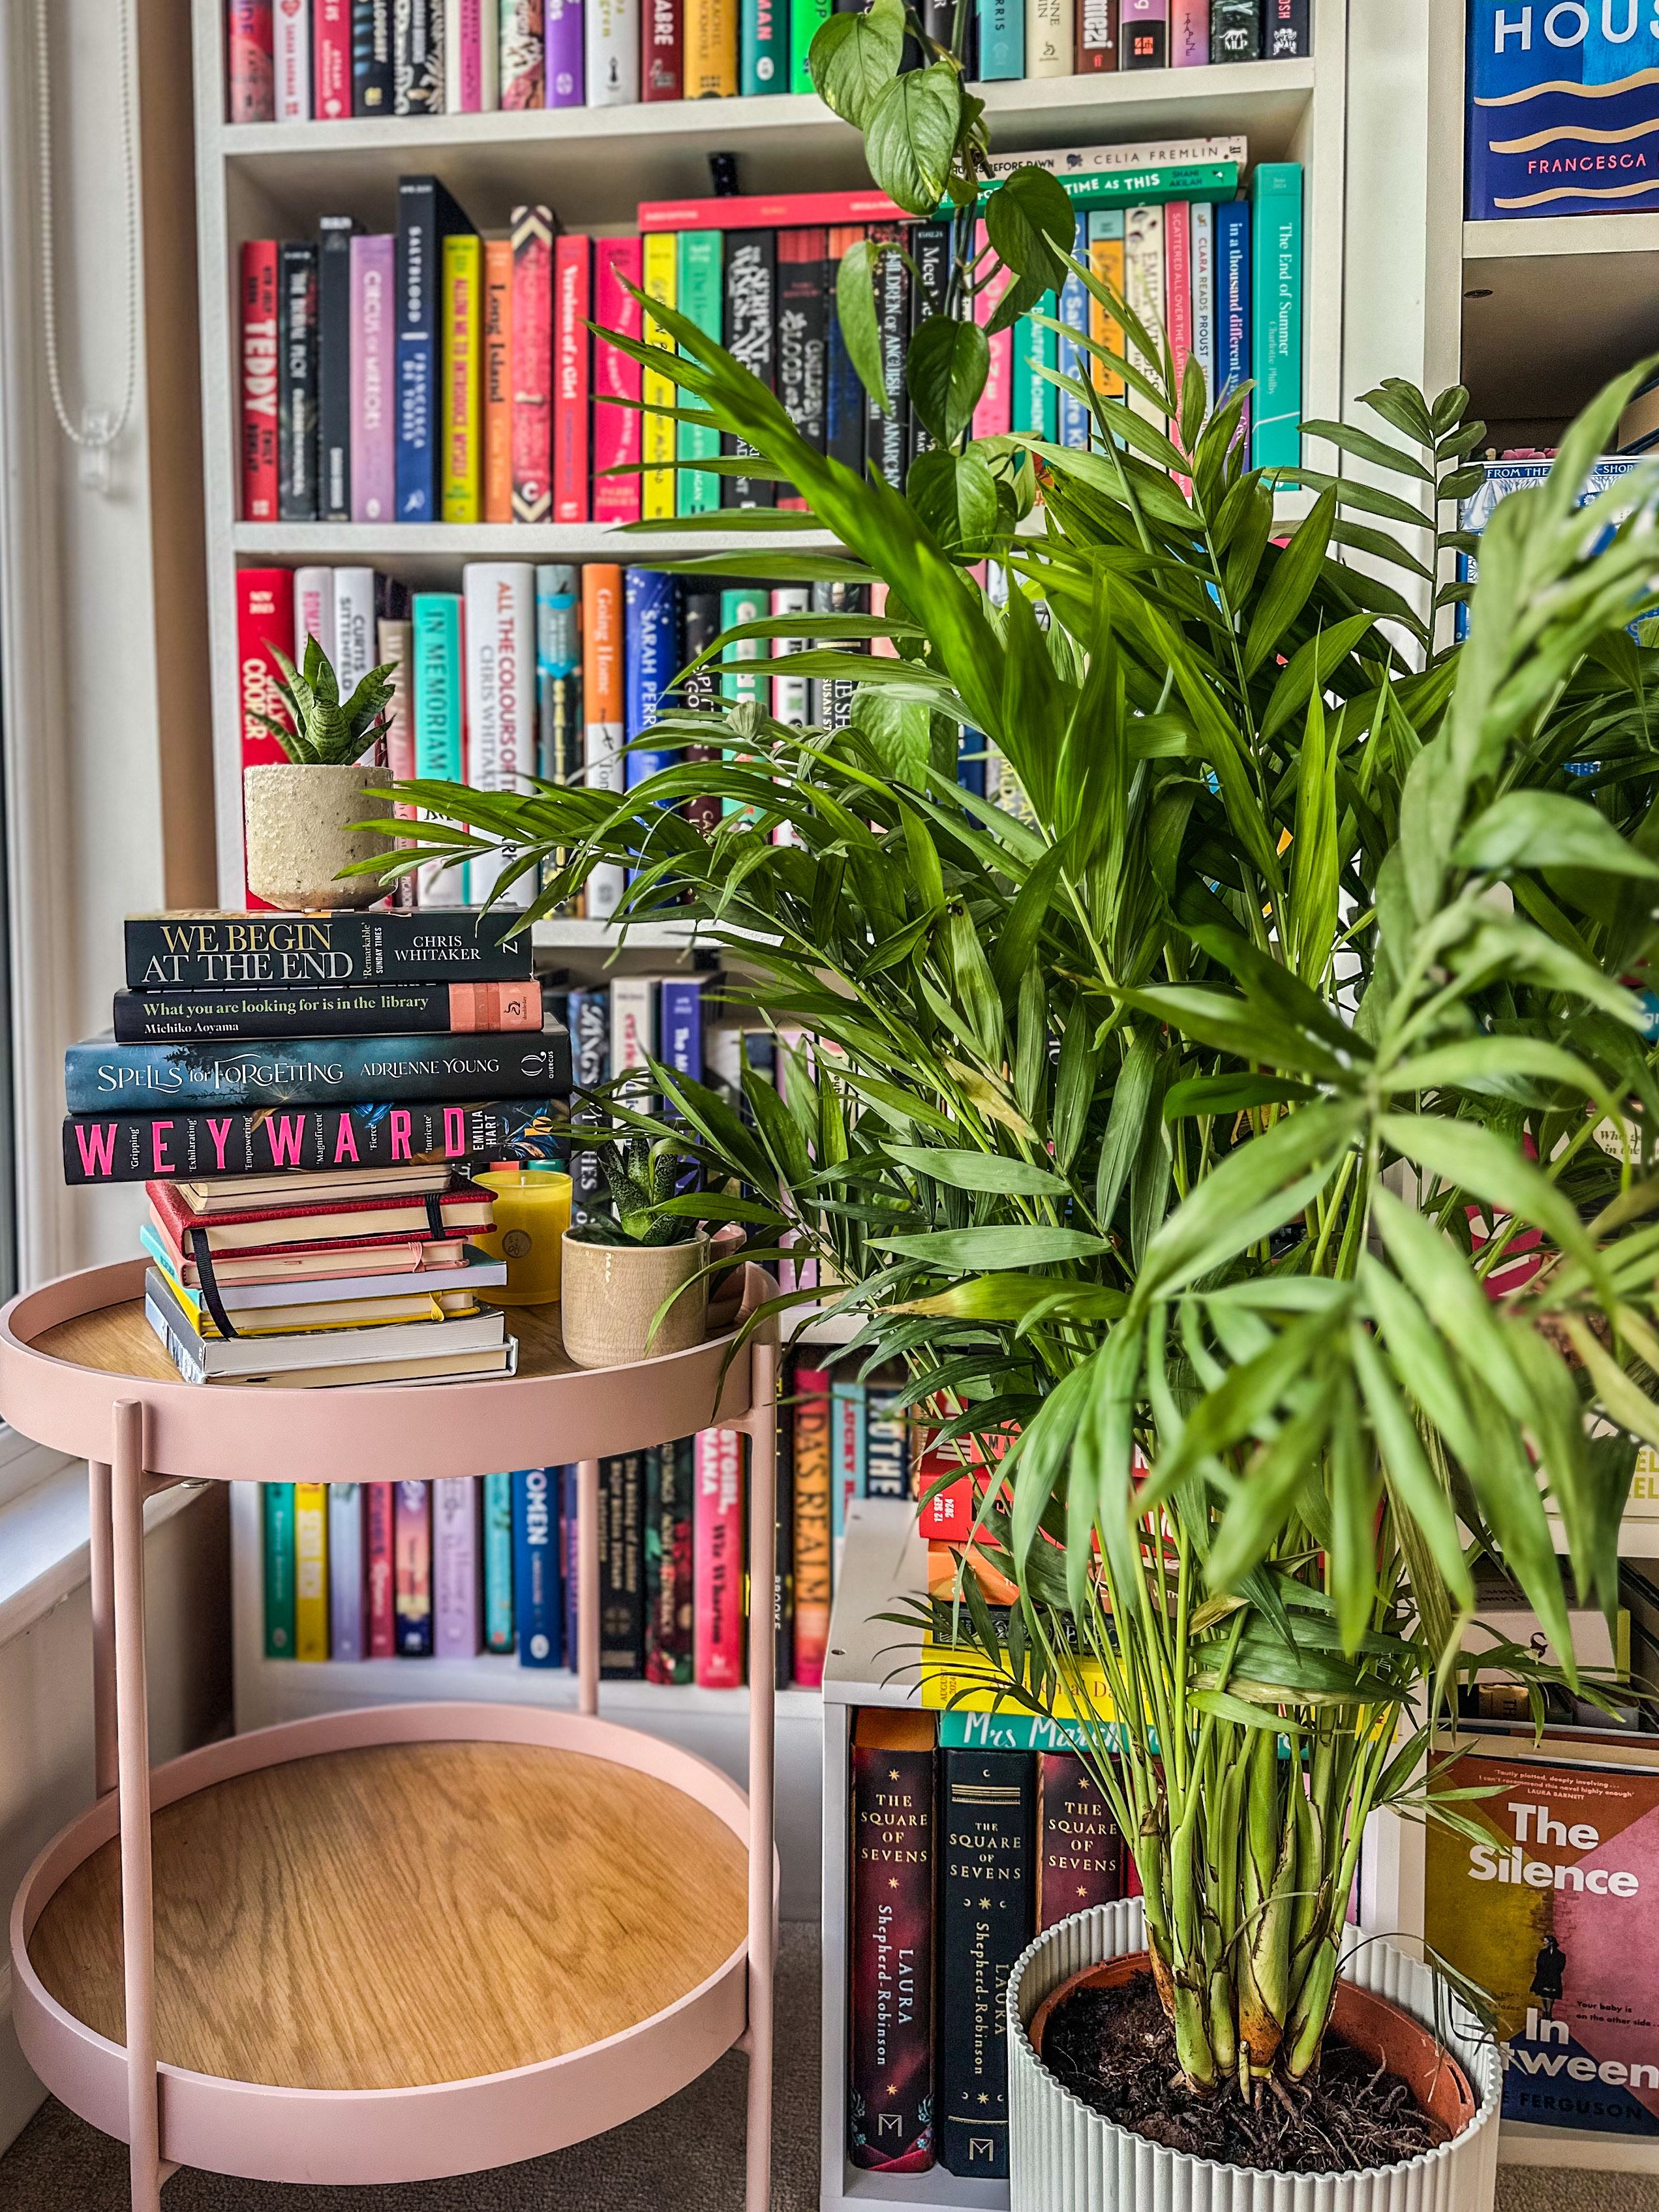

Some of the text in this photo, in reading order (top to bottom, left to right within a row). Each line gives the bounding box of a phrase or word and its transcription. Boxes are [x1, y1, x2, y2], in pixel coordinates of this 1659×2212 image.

[1093, 146, 1219, 166] CELIA FREMLIN
[1528, 153, 1647, 174] FRANCESCA
[1066, 173, 1161, 195] TIME AS THIS
[407, 226, 421, 323] SALTBLOOD
[923, 247, 940, 286] Meet
[1173, 213, 1185, 378] SCATTERED ALL OVER THE EARTH
[1198, 237, 1209, 357] CLARA READS PROUST
[1229, 222, 1243, 372] in a thousand different
[1279, 222, 1293, 356] The End of Summer
[486, 283, 506, 335] Long
[885, 315, 898, 331] OF
[562, 265, 578, 399] Versions of Girl
[363, 271, 383, 429] CIRCUS MIRRORS
[883, 334, 901, 395] ANGUISH
[1266, 320, 1277, 395] Charlotte Philby
[245, 320, 278, 416] TEDDY
[489, 342, 506, 402] Island
[413, 352, 427, 449] FRANCESCA
[1487, 467, 1548, 479] FROM THE
[340, 597, 353, 690] SITTENFELD
[353, 615, 366, 673] CURTIS
[593, 588, 612, 695] Going Home
[641, 609, 658, 674] SARAH
[427, 611, 447, 770] IN MEMORIAM
[498, 583, 516, 773] ALL THE COLOURS OF
[480, 645, 496, 792] CHRIS WHITAKE
[160, 924, 333, 953] WE BEGIN
[394, 947, 481, 962] WHITAKER
[413, 935, 462, 948] CHRIS
[142, 950, 354, 982] AT THE END
[375, 947, 384, 974] SUNDAY
[143, 994, 429, 1018] What you are looking for is in the library
[144, 1022, 239, 1035] Michiko Aoyama
[677, 1027, 690, 1051] The
[98, 1053, 344, 1094] SPELLS for FORGETTING
[360, 1057, 500, 1078] ADRIENNE YOUNG
[472, 1110, 484, 1151] EMILIA
[485, 1114, 497, 1145] HART
[526, 1468, 549, 1545] OMEN
[934, 1492, 944, 1523] 12 SEPT
[943, 1498, 955, 1519] 2024
[796, 1491, 827, 1604] REALM
[712, 1564, 726, 1644] Wharton
[963, 1712, 1017, 1748] Mrs
[1527, 1788, 1585, 1800] LAURA BARNETT
[1549, 1775, 1574, 1785] deeply
[1575, 1778, 1609, 1789] involving
[1581, 1786, 1604, 1796] highly
[876, 1794, 912, 1808] THE
[1065, 1802, 1102, 1817] THE
[860, 1810, 928, 1827] SQUARE
[975, 1822, 998, 1832] THE
[1048, 1818, 1118, 1836] SQUARE
[1508, 1802, 1600, 1851] The
[882, 1831, 906, 1844] OF
[949, 1833, 1022, 1849] SQUARE
[1070, 1838, 1095, 1853] OF
[860, 1847, 928, 1864] SEVENS
[949, 1864, 1021, 1880] SEVENS
[979, 1853, 996, 1863] OF
[1048, 1855, 1116, 1872] SEVENS
[1468, 1844, 1639, 1898] Silence
[877, 1904, 893, 2067] Shepherd-Robinson
[898, 1948, 914, 2026] LAURA
[975, 1922, 990, 2076] Shepherd-Robinson
[995, 1963, 1006, 2036] LAURA
[1577, 2001, 1598, 2010] Your
[1600, 2003, 1623, 2014] baby
[1590, 2013, 1605, 2022] the
[1606, 2016, 1632, 2025] other
[1633, 2019, 1651, 2027] side
[1526, 2007, 1570, 2046] In
[1499, 2042, 1659, 2089] tween
[1519, 2092, 1643, 2121] FERGUSON
